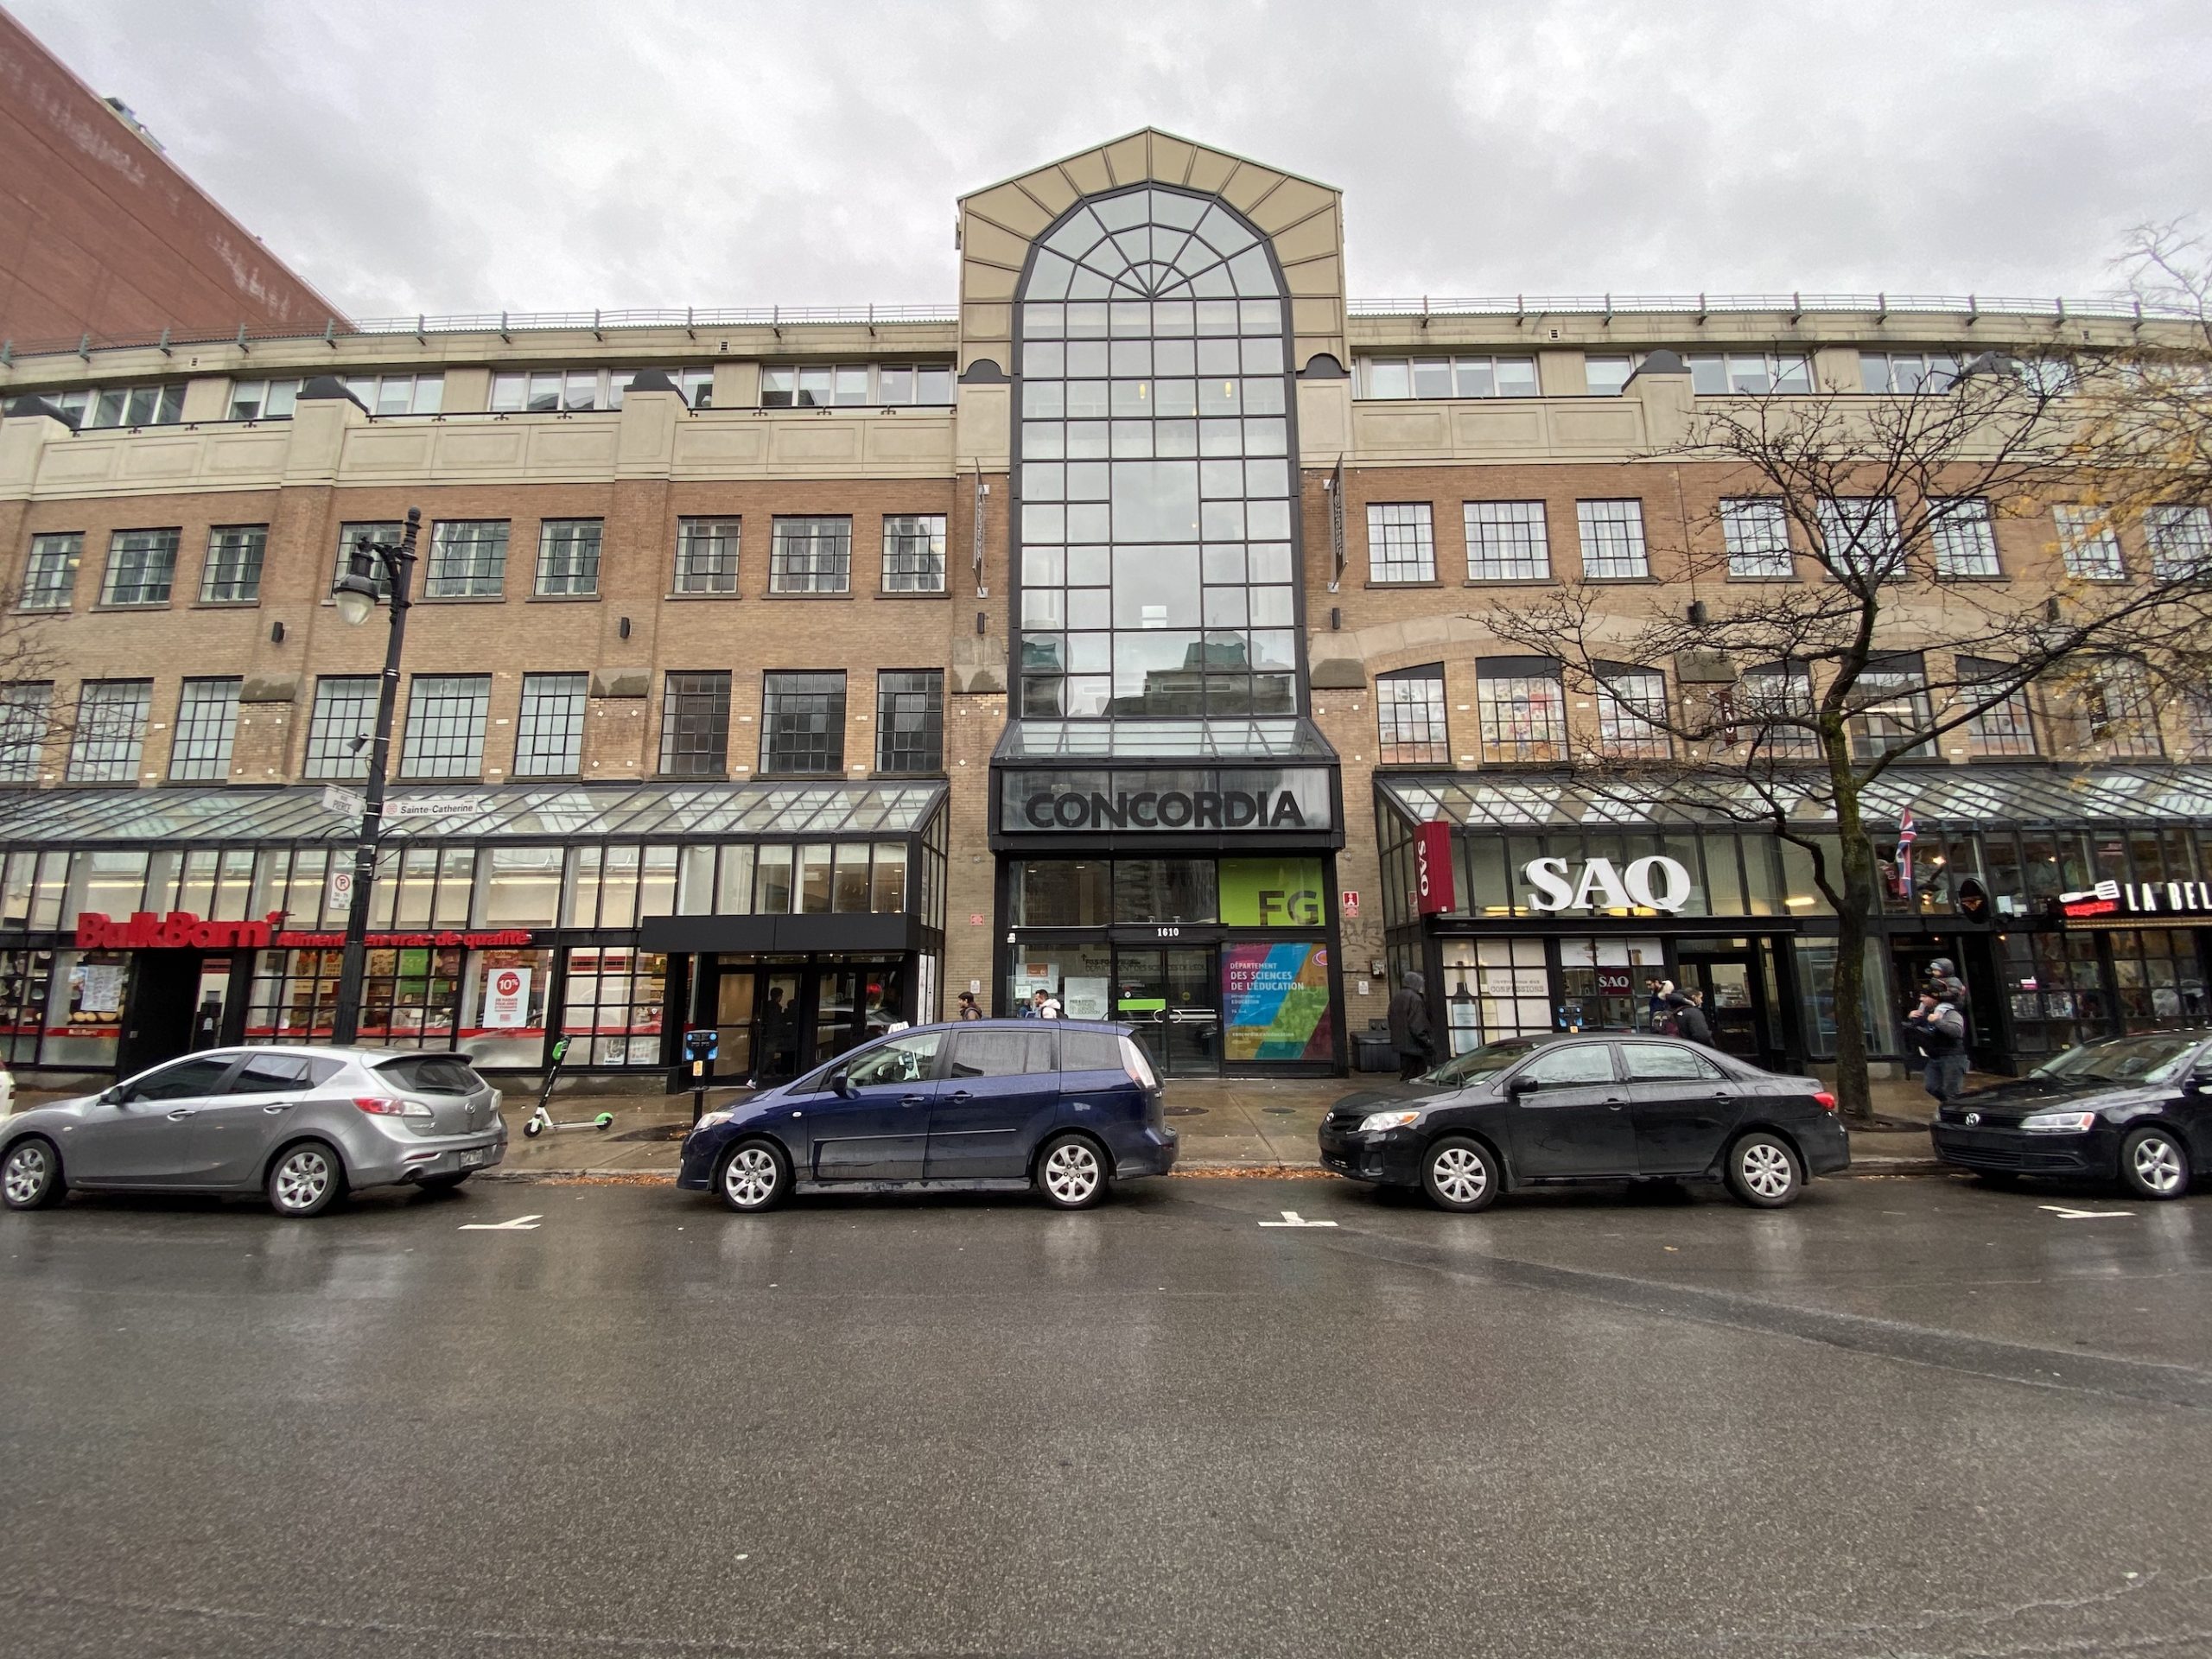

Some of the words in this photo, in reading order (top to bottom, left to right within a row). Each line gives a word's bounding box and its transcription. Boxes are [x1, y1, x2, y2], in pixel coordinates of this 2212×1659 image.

[333, 800, 353, 813] PIERCE
[400, 804, 474, 814] Sainte-Catherine
[1026, 790, 1306, 828] CONCORDIA
[1526, 855, 1691, 913] SAQ
[2125, 882, 2157, 911] LA
[1259, 890, 1319, 926] FG
[435, 930, 463, 946] de
[1157, 927, 1179, 937] 1610
[1230, 961, 1278, 969] DÉPARTEMENT
[1230, 971, 1248, 980] DES
[1251, 971, 1293, 980] SCIENCES
[1230, 982, 1243, 990] DE
[1598, 976, 1630, 988] SAQ
